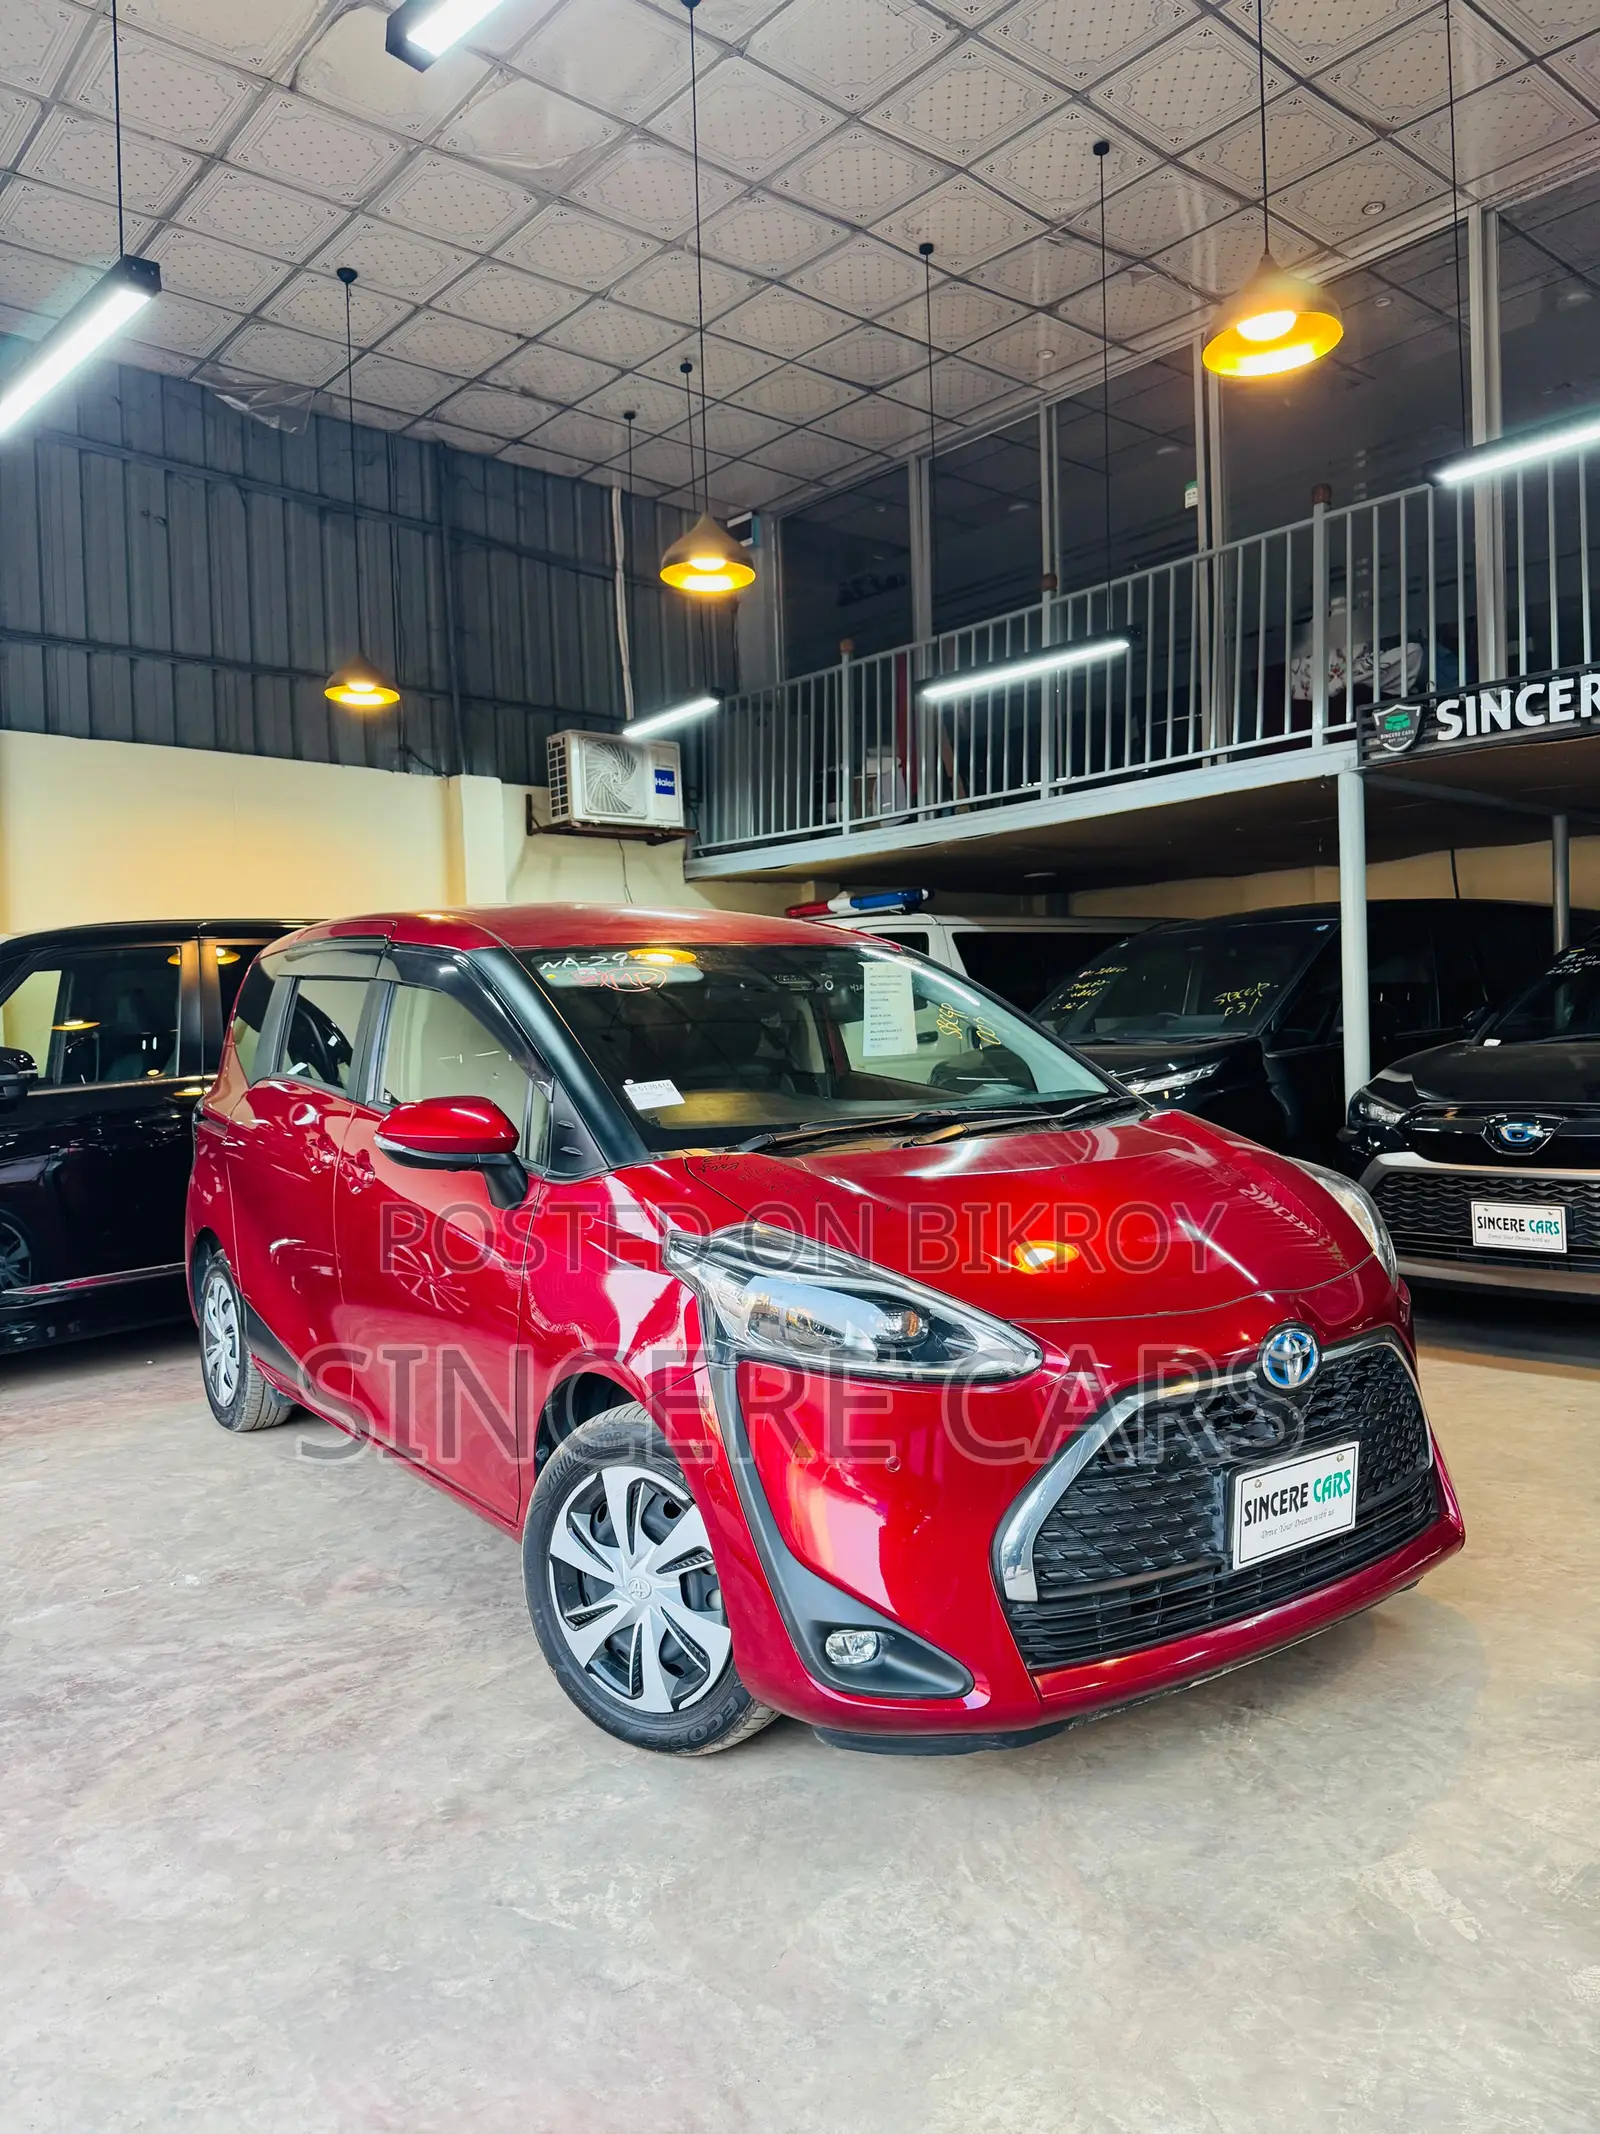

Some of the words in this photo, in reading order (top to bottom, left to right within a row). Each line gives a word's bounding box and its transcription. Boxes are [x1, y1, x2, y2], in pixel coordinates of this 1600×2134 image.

[1436, 673, 1600, 741] SINCER
[655, 777, 676, 788] Haier
[1477, 1216, 1525, 1233] SINCERE
[1528, 1220, 1560, 1236] CARS
[1244, 1482, 1309, 1527] SINCERE
[1313, 1469, 1351, 1504] CARS
